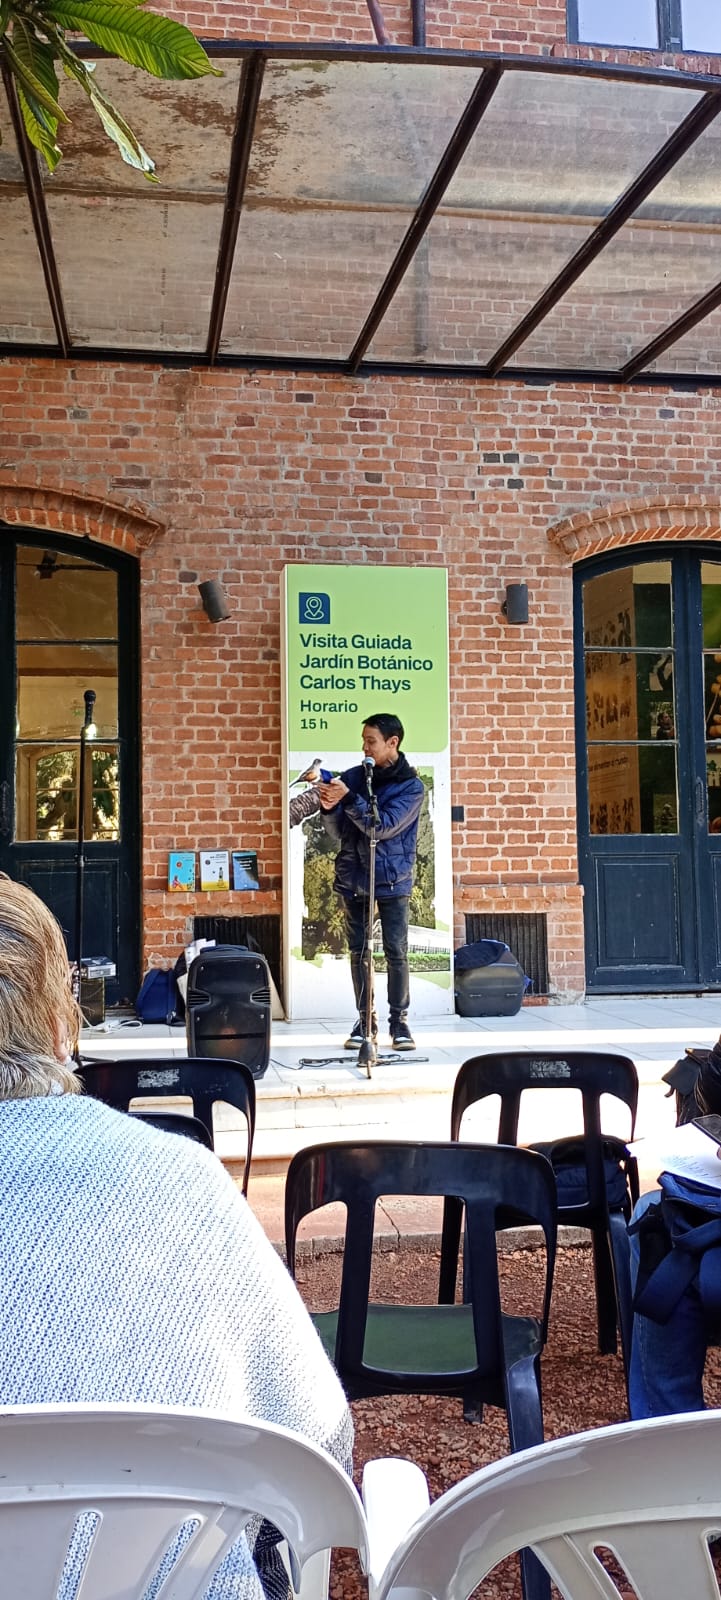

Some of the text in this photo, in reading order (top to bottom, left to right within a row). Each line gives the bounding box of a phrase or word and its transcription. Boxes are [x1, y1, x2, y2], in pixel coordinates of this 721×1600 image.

[299, 632, 413, 650] Visita Guiada
[299, 653, 433, 671] Jardín Botánico
[300, 674, 411, 694] Carlos Thays
[300, 699, 358, 713] Horario
[300, 718, 329, 730] 15 h
